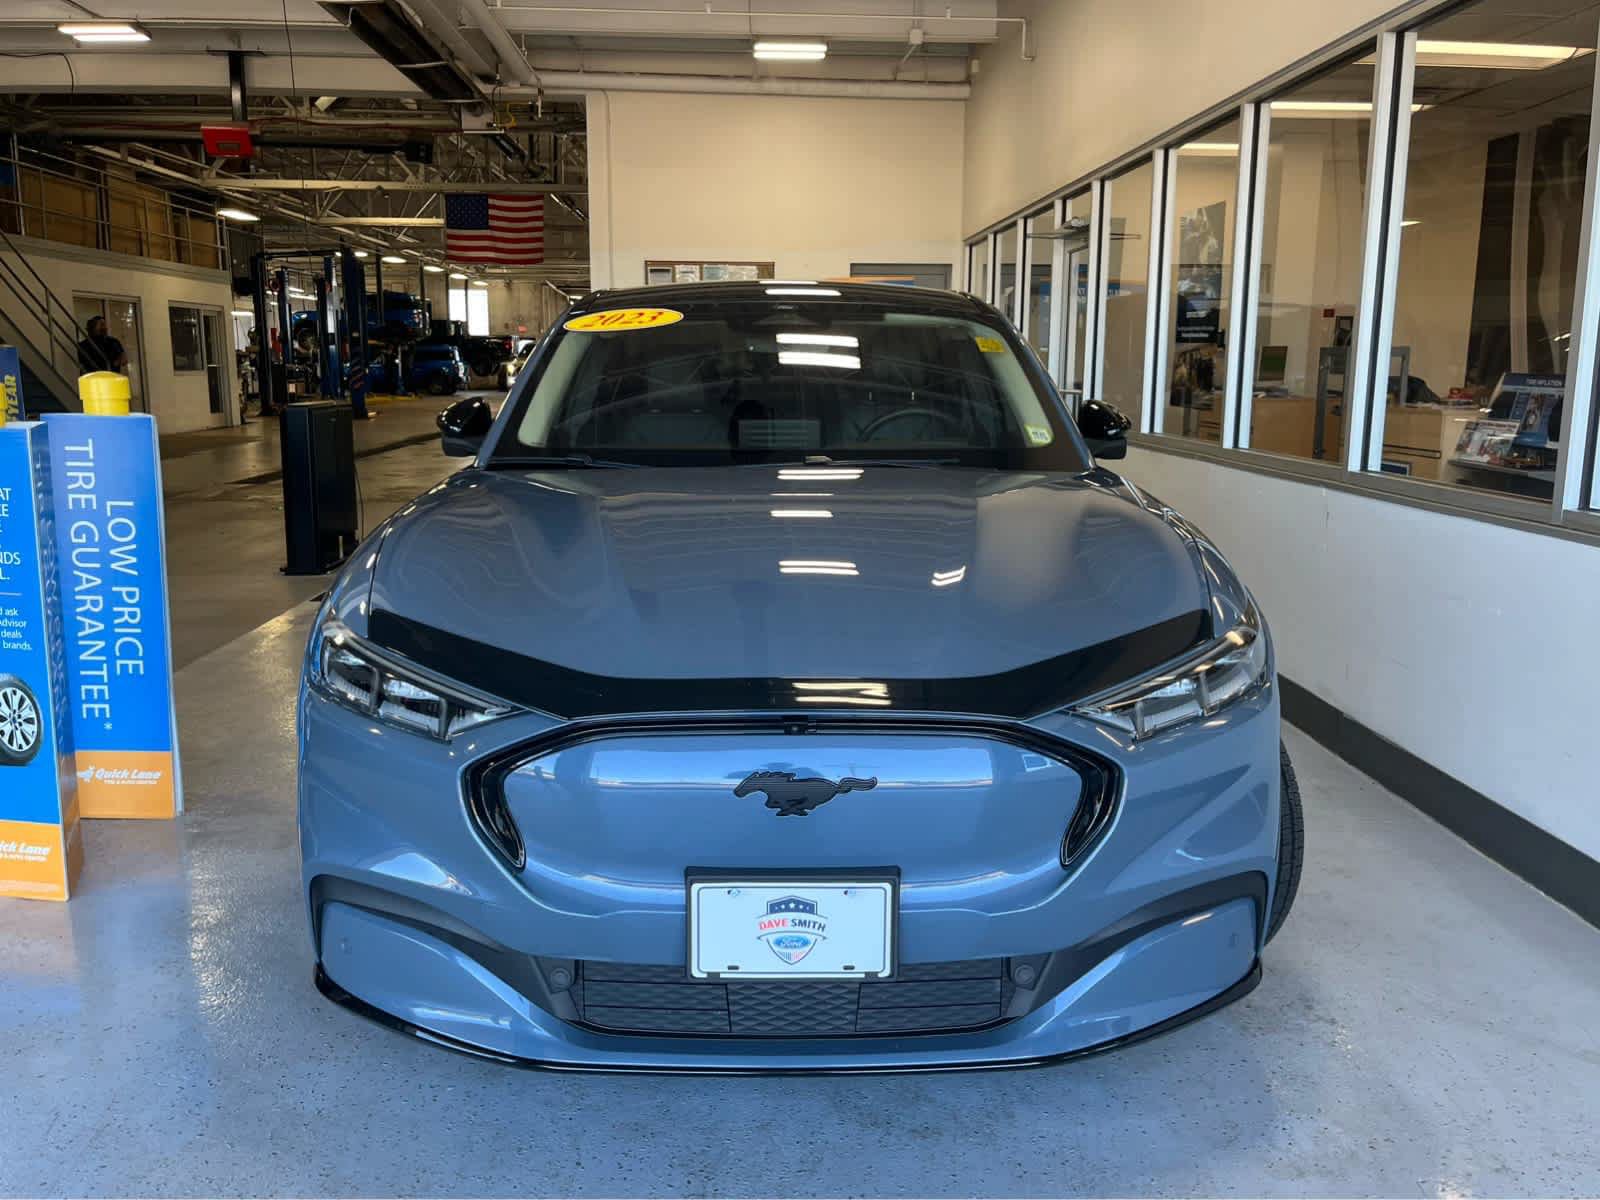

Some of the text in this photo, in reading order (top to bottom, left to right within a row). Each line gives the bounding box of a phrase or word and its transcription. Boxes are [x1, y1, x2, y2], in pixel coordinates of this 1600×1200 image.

[583, 311, 665, 328] 2023
[64, 438, 97, 510] TIRE
[106, 501, 144, 676] LOW PRICE
[95, 768, 161, 780] Quick Lane
[18, 842, 51, 855] Lane
[759, 918, 826, 933] DAVE SMITH
